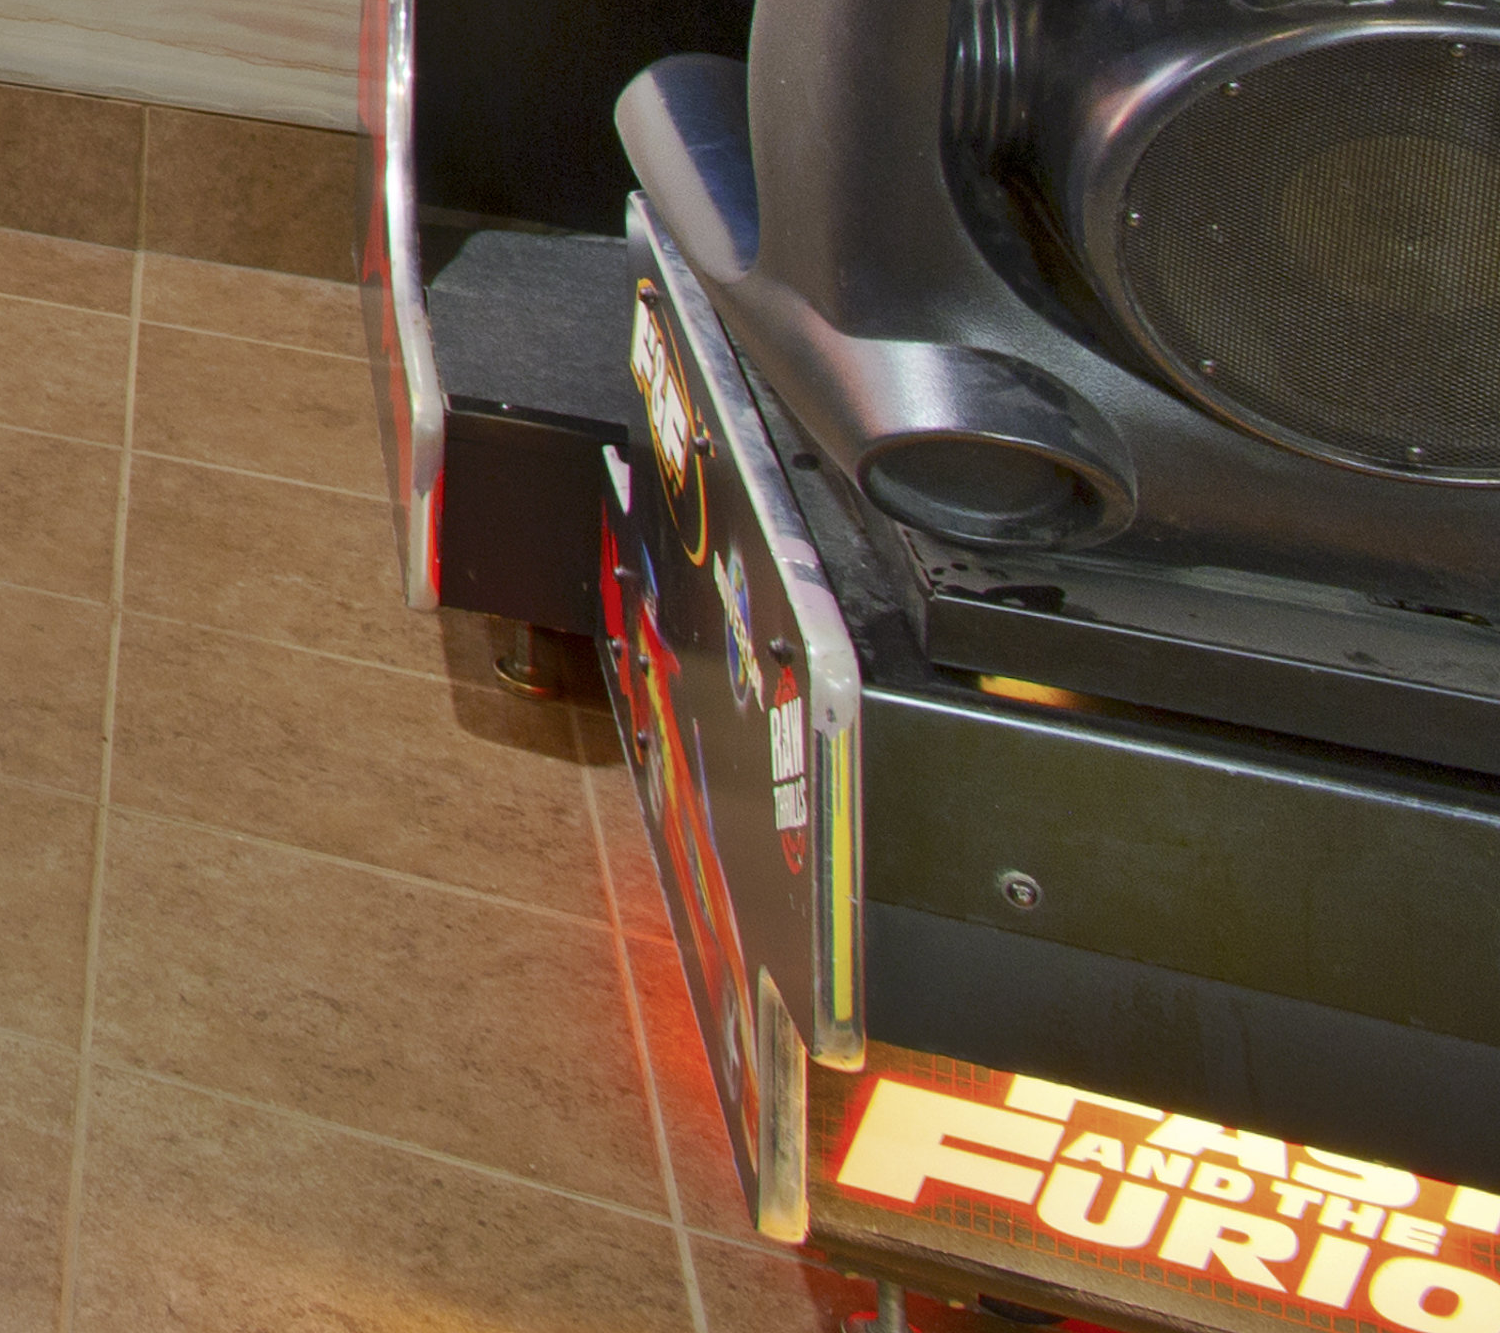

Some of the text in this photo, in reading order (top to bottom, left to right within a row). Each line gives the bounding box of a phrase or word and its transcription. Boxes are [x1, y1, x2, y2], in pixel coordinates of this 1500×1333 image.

[768, 697, 804, 781] RAW
[836, 1078, 1500, 1333] FURIO
[1061, 1131, 1449, 1258] AND THE
